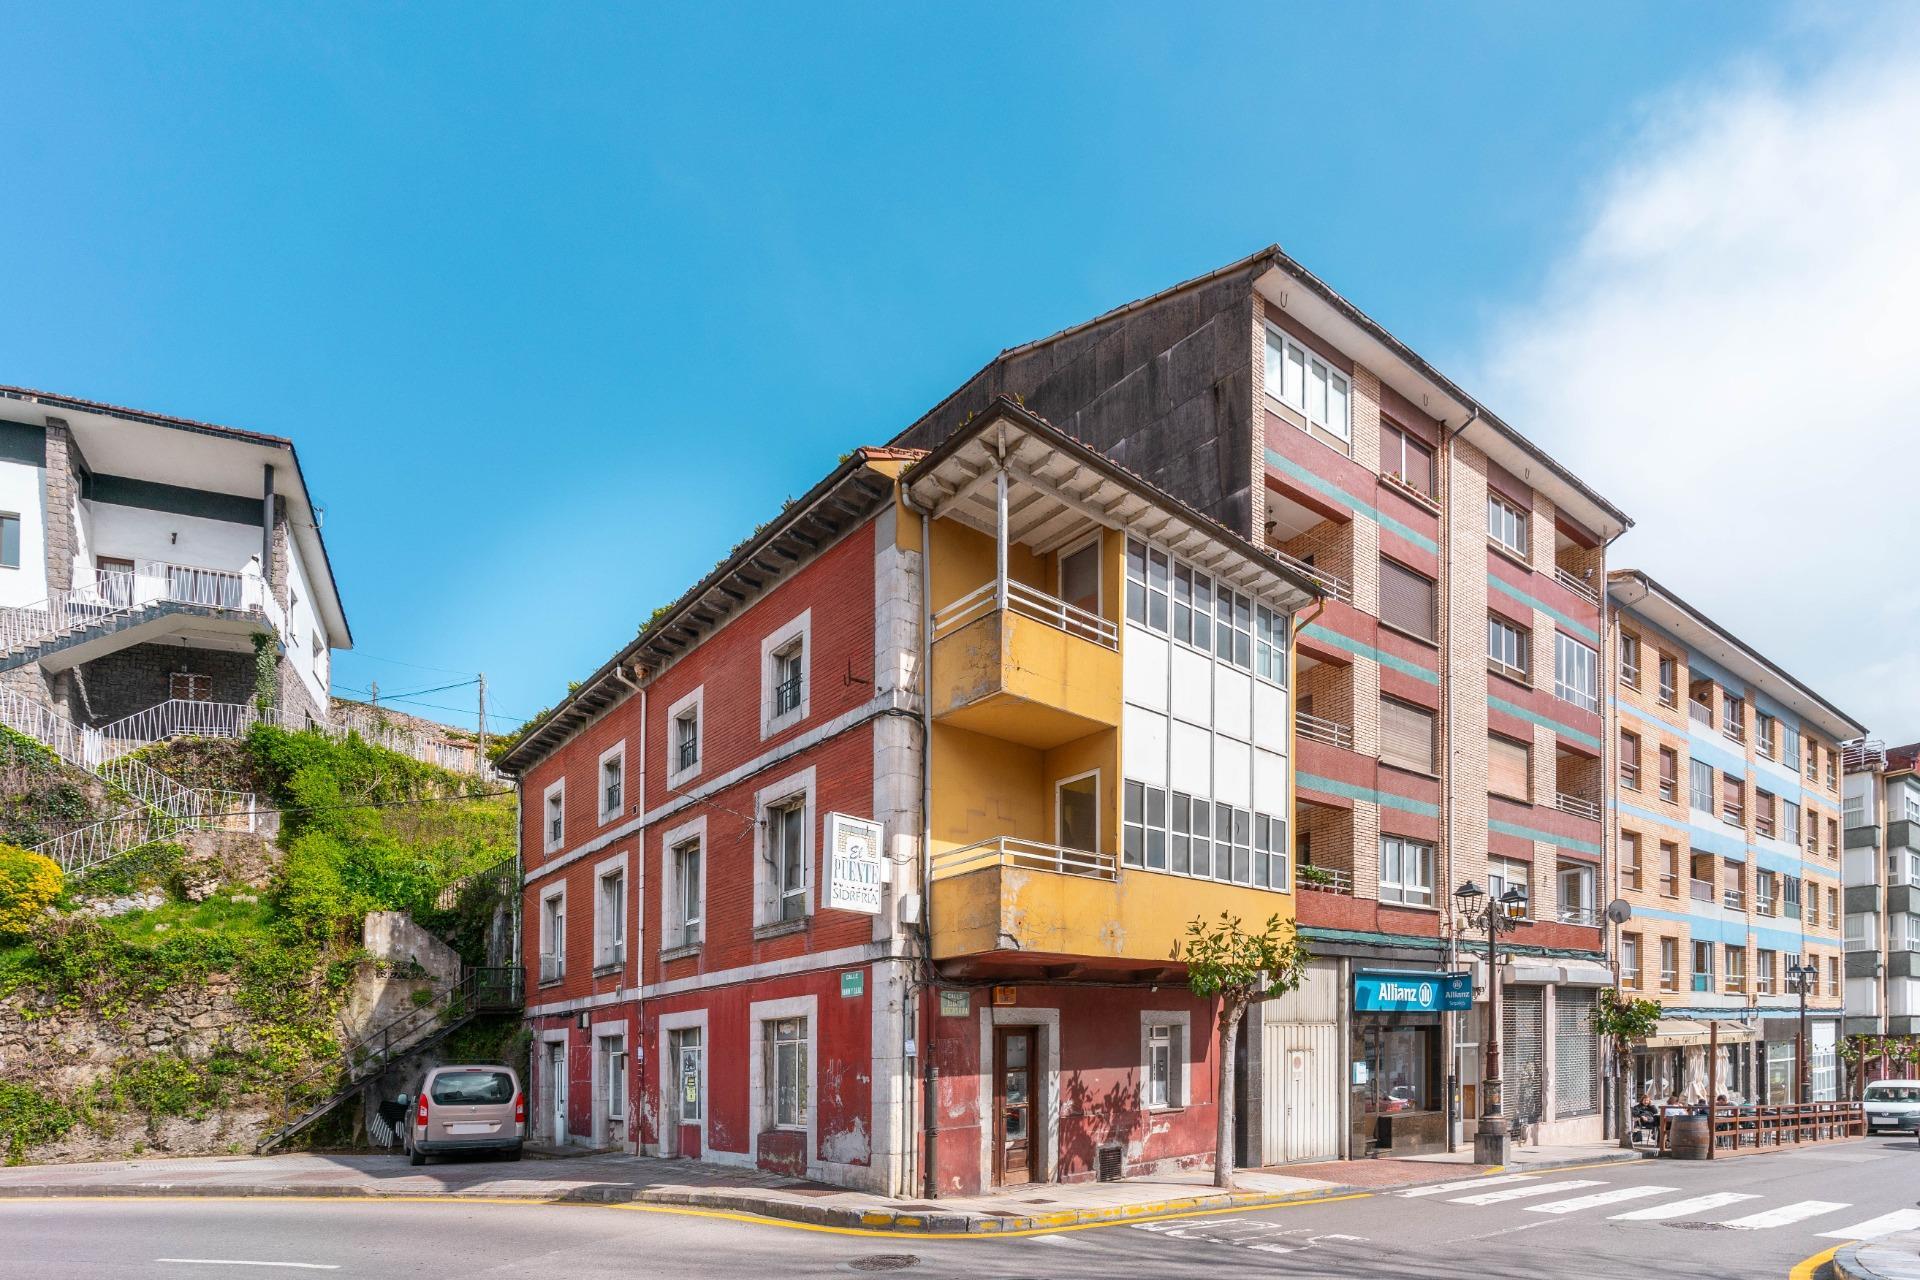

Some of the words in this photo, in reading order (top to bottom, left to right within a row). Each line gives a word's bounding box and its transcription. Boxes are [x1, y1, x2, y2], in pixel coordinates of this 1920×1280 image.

[850, 845, 863, 859] El
[834, 857, 879, 885] PUENTE
[1378, 982, 1417, 1002] Allianz
[1445, 991, 1470, 999] Allianz
